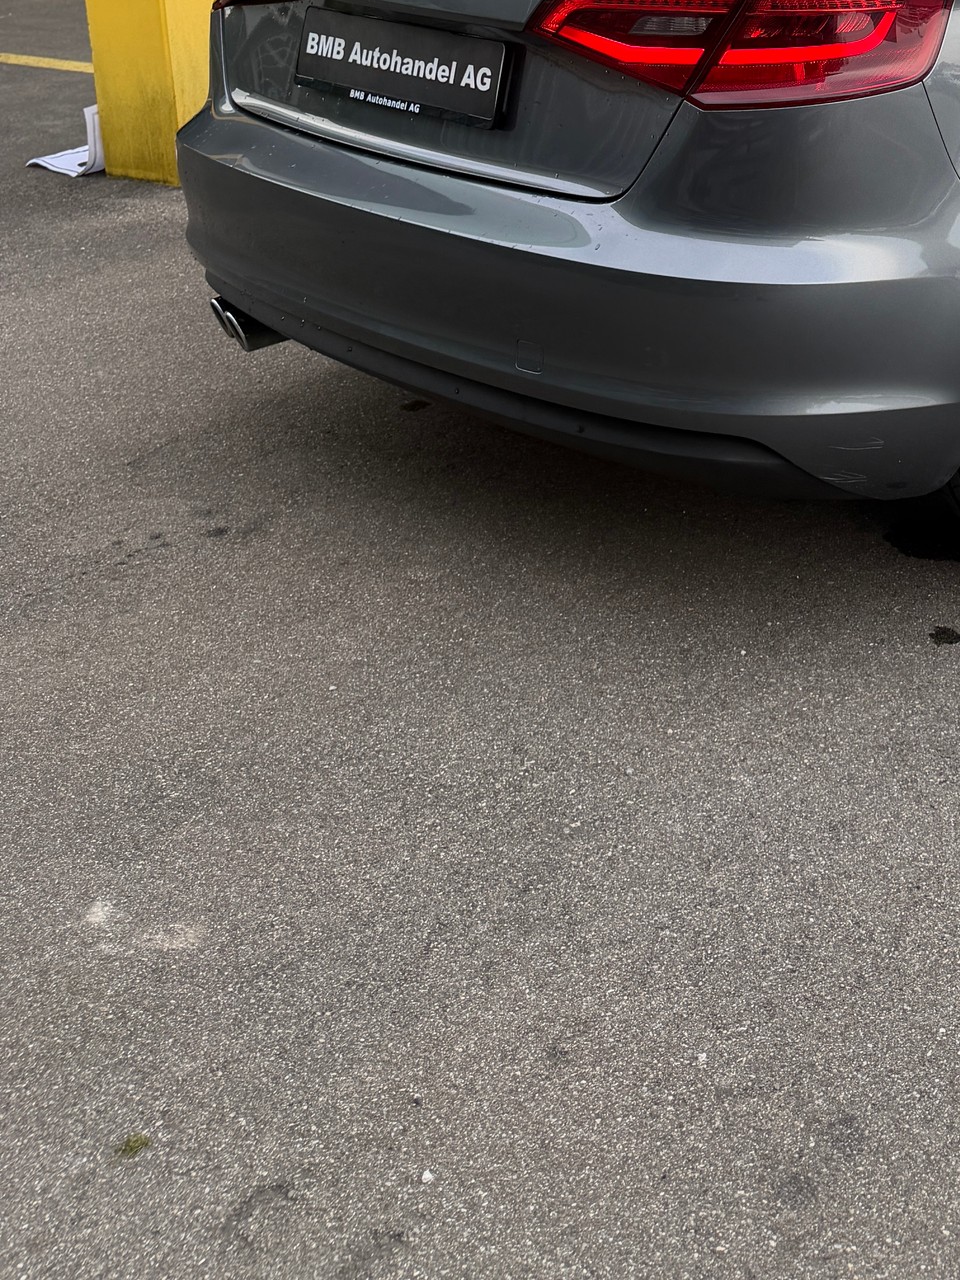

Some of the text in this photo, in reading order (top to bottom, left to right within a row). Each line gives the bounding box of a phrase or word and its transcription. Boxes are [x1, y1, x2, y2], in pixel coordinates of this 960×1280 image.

[305, 31, 493, 92] BMB Autohandel AG
[349, 89, 420, 114] BMB Autohandel AG
